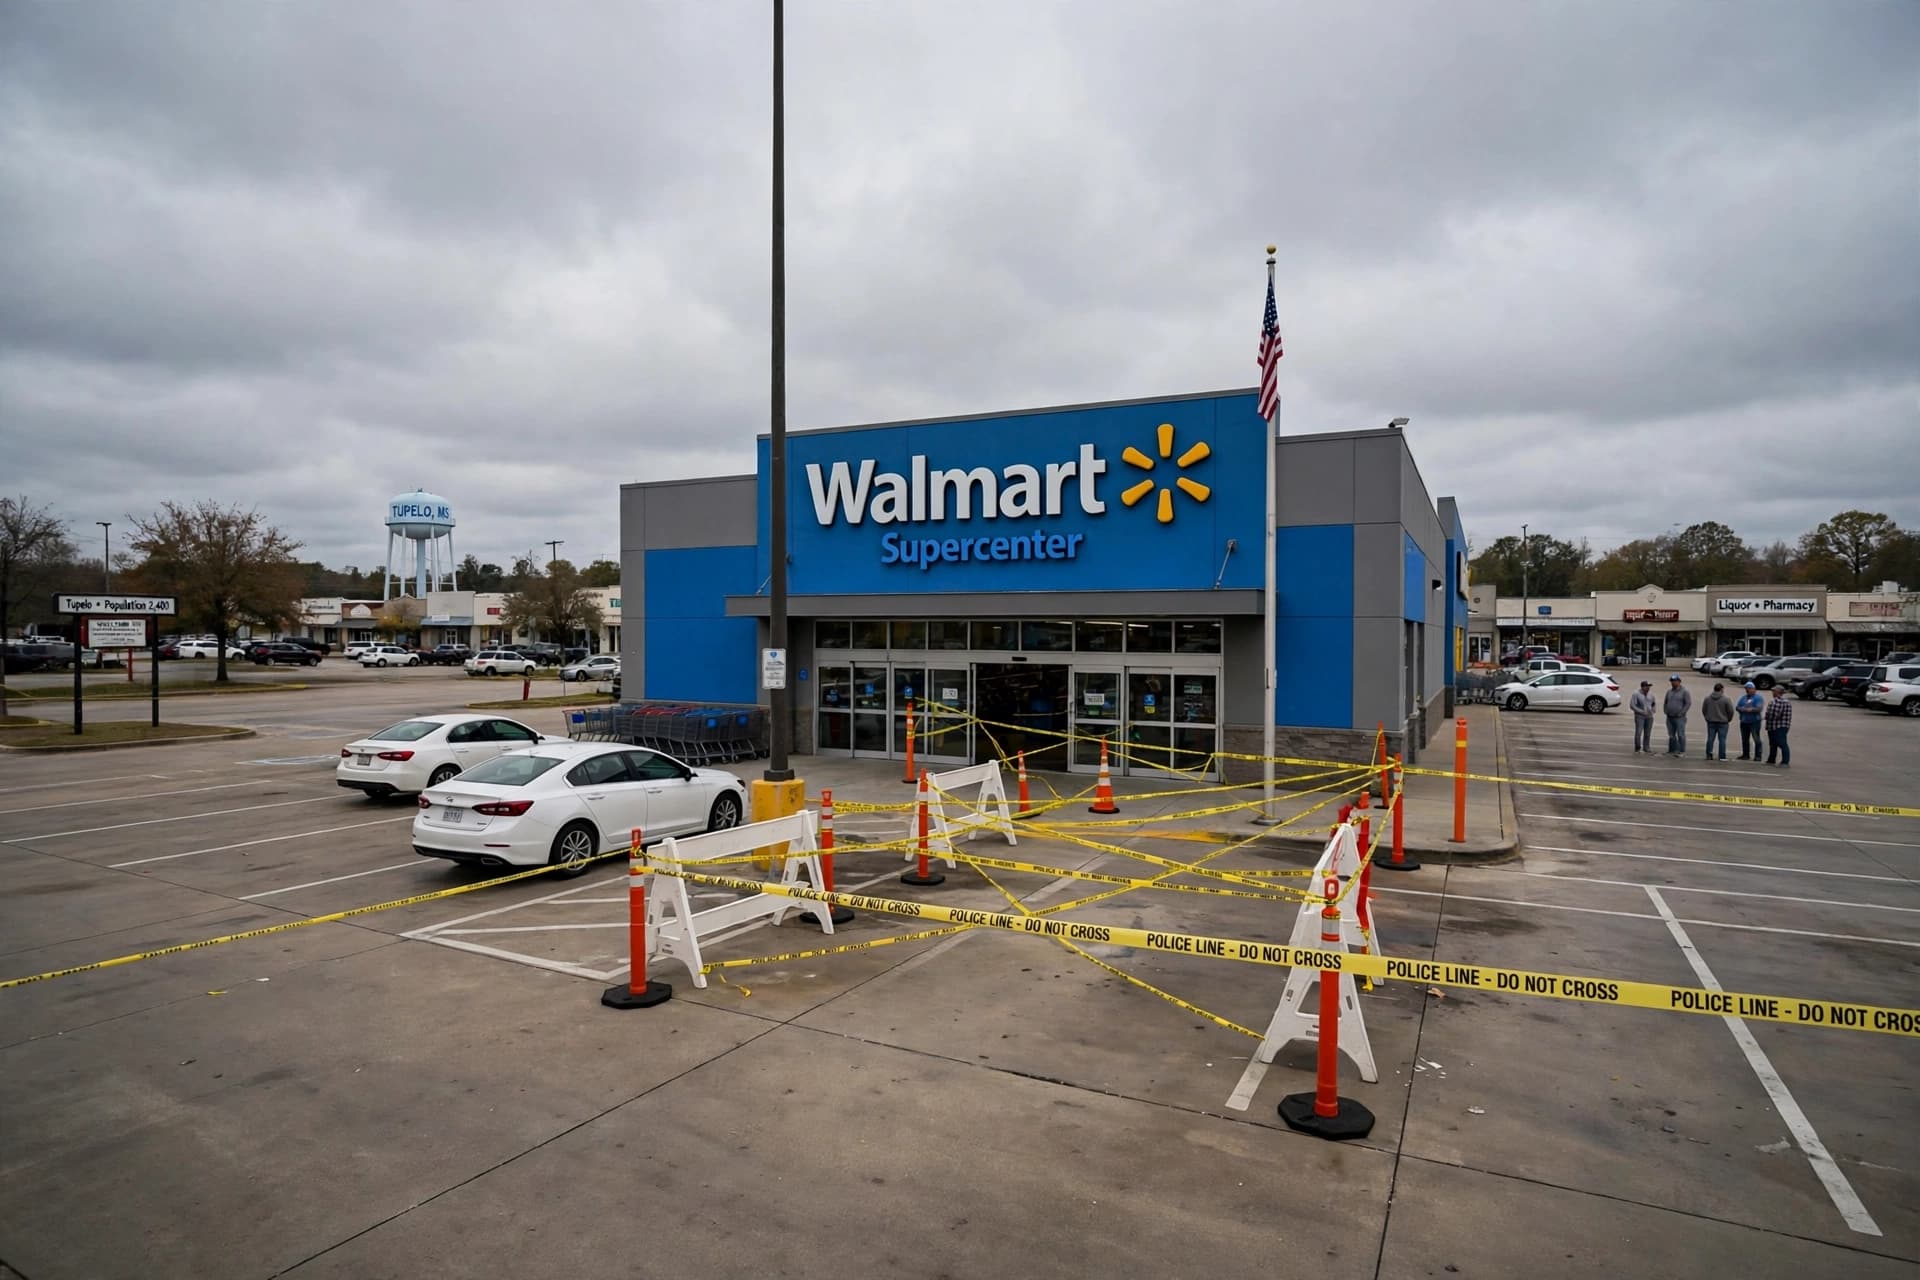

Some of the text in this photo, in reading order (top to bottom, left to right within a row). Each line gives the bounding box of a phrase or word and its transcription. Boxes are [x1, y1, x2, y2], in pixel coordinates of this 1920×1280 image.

[805, 443, 1106, 526] Walmart
[392, 504, 450, 520] TUPELO, MS
[881, 529, 1083, 570] Supercenter
[66, 599, 92, 611] Tupelo
[104, 599, 146, 612] Population
[1719, 599, 1815, 613] Liquor Pharmacy
[787, 887, 818, 901] POLICE
[821, 892, 841, 904] LINE
[850, 896, 864, 907] DO
[866, 898, 885, 910] NOT
[888, 901, 920, 916] CROSS
[950, 909, 986, 925] POLICE
[989, 915, 1014, 929] LINE
[1025, 918, 1041, 933] DO
[1045, 920, 1067, 936] NOT
[1070, 924, 1110, 941] CROSS
[1147, 933, 1192, 951] POLICE
[1196, 939, 1225, 956] LINE
[1239, 943, 1258, 960] DO
[1263, 947, 1290, 963] NOT
[1294, 950, 1342, 969] CROSS
[1386, 960, 1440, 982] POLICE
[1445, 967, 1480, 985] LINE
[1497, 972, 1519, 990] DO
[1525, 975, 1557, 994] NOT
[1562, 979, 1618, 1001] CROSS
[1671, 990, 1732, 1013] POLICE
[1739, 998, 1778, 1018] LINE
[1798, 1003, 1824, 1023] DO
[1831, 1006, 1868, 1028] NOT
